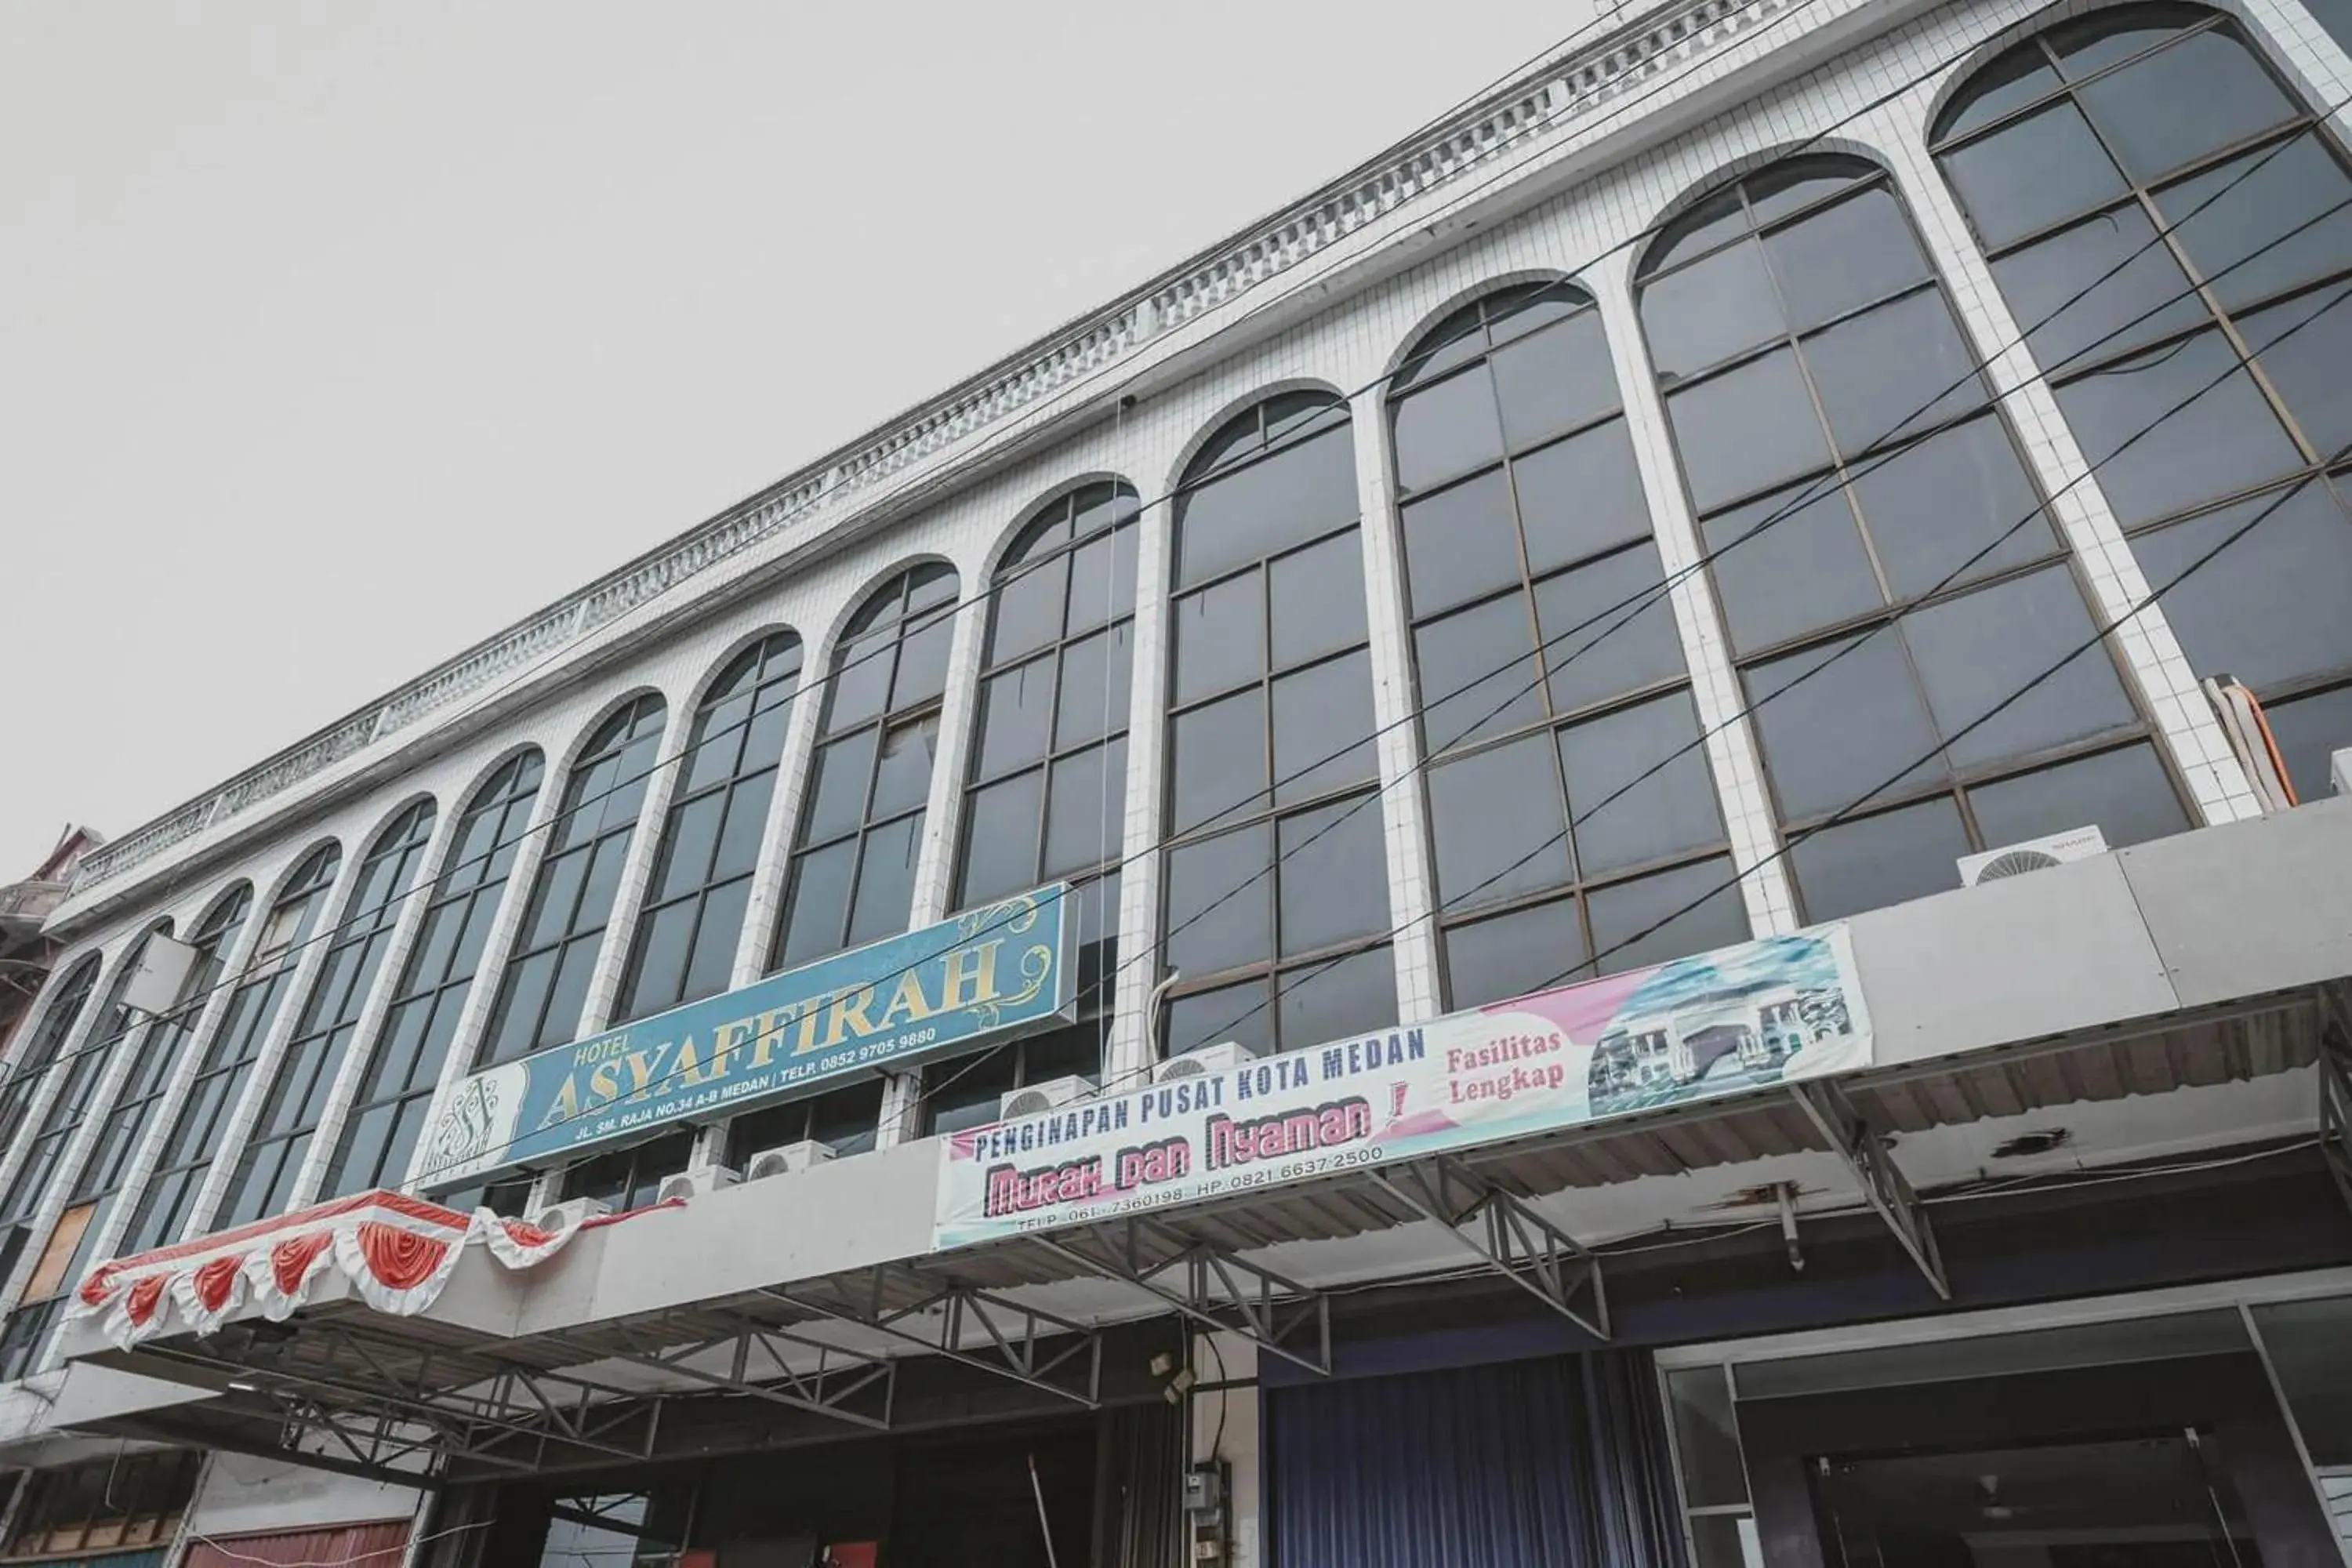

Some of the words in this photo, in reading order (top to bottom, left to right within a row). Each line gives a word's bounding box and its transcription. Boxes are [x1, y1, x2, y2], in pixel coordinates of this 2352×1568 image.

[536, 938, 1004, 1131] ASYAFFIRAH
[574, 1034, 630, 1066] HOTEL
[1446, 1032, 1562, 1073] Fasilitas
[620, 1108, 652, 1128] RAJA
[720, 1075, 769, 1099] MEDAN
[821, 1051, 855, 1071] 0852
[859, 1039, 895, 1060] 9705
[899, 1028, 935, 1048] 9880
[974, 1099, 1128, 1162] PENGINAPAN
[1142, 1076, 1225, 1123] PUSAT
[1238, 1057, 1308, 1100] KOTA
[1323, 1028, 1425, 1080] MEDAN
[1449, 1063, 1564, 1104] Lengkap
[1230, 1169, 1272, 1188] 0821
[1333, 1146, 1383, 1167] 2500
